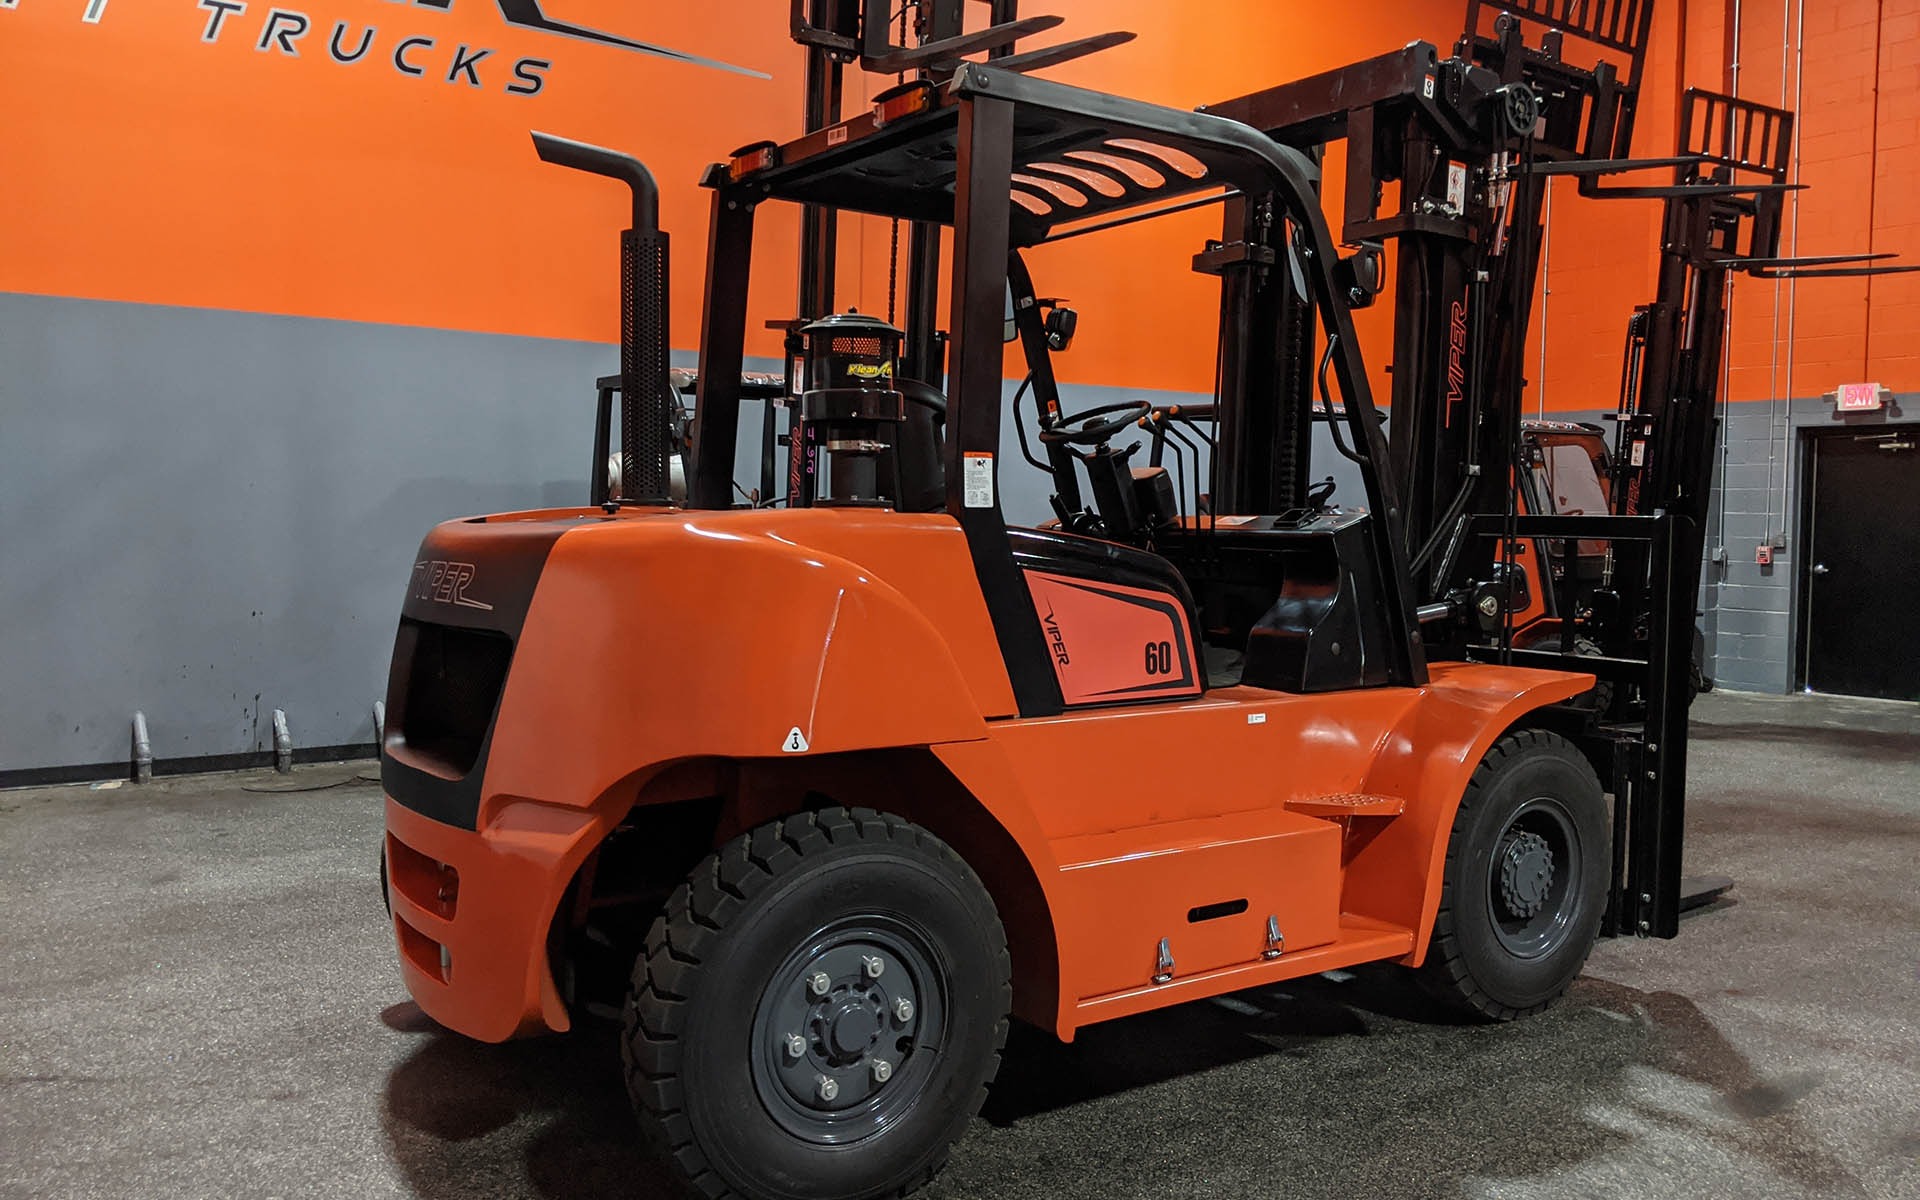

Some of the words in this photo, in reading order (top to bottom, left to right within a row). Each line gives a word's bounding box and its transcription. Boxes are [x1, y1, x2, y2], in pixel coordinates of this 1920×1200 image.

[197, 0, 554, 96] TRUCKS
[1446, 284, 1468, 428] VIPER
[789, 417, 802, 508] VIPER
[1044, 599, 1070, 675] VIPER
[1145, 641, 1171, 675] 60
